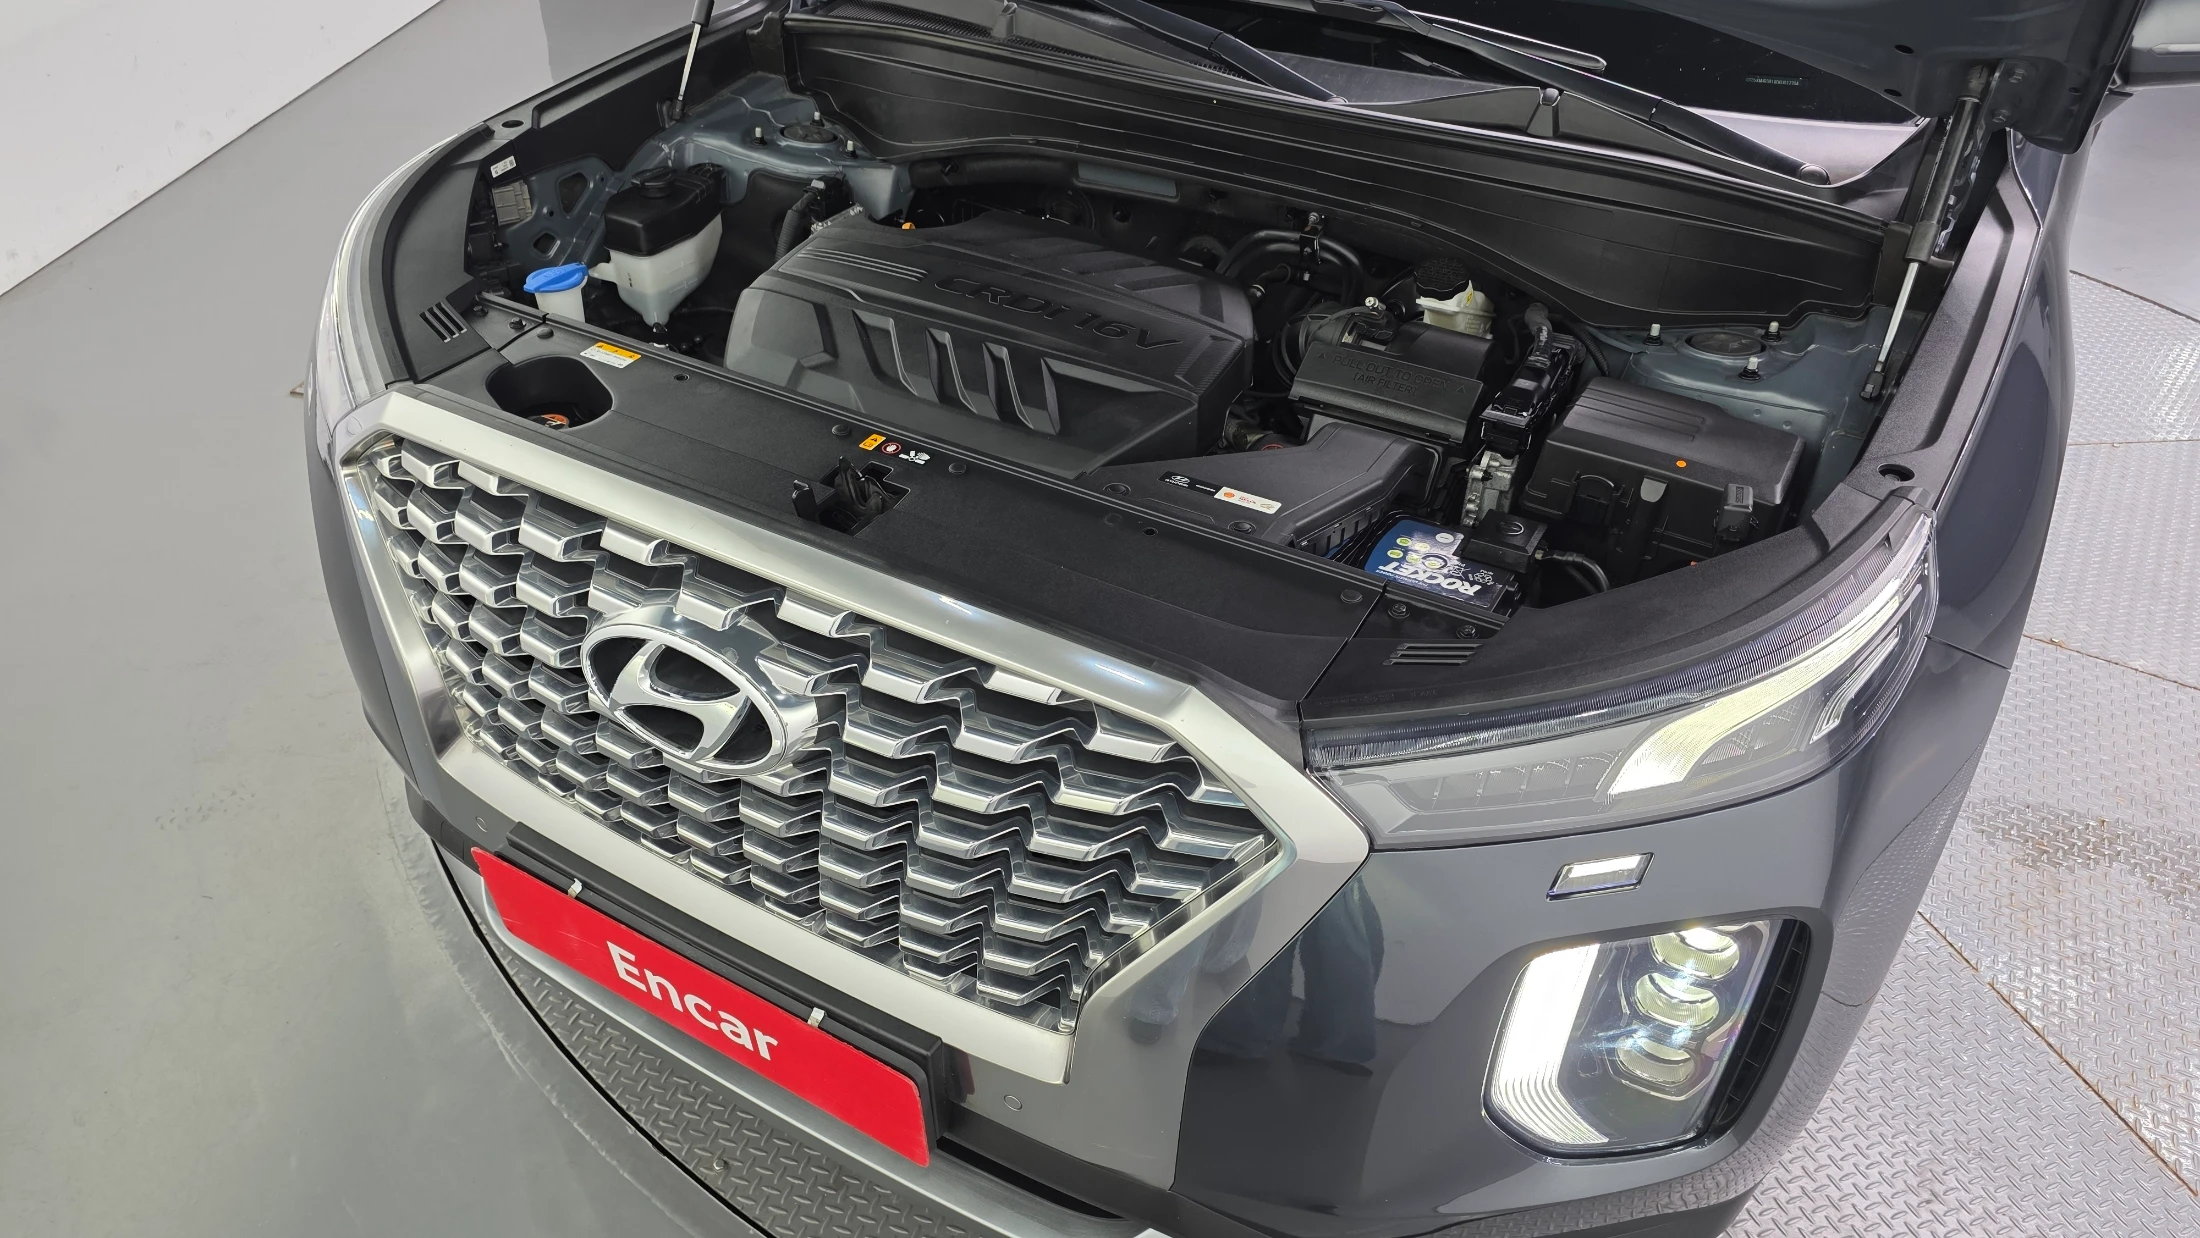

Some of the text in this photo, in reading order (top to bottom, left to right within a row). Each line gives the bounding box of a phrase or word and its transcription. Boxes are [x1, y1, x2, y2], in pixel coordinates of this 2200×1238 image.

[1074, 312, 1183, 350] 16V
[1333, 355, 1450, 391] PULL OUT TO OPEN
[1378, 561, 1482, 597] ROCKET
[606, 940, 779, 1062] Encar
